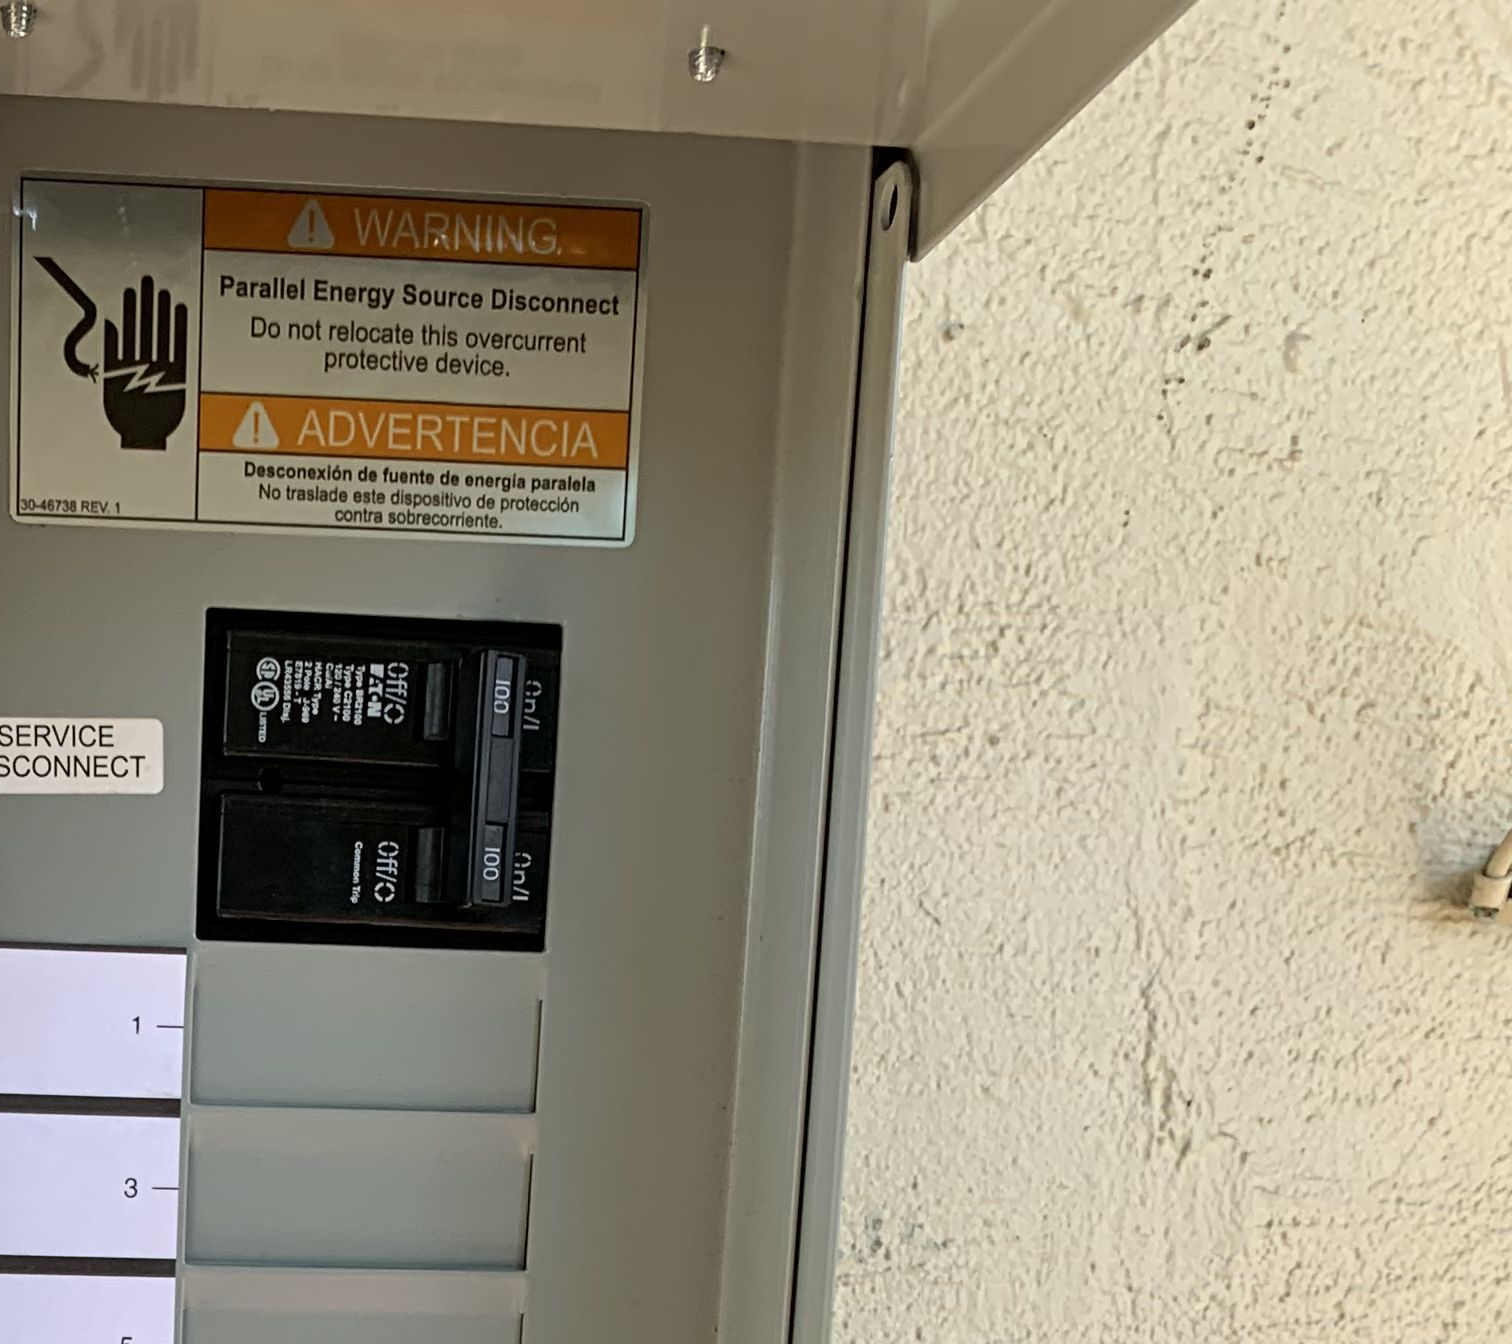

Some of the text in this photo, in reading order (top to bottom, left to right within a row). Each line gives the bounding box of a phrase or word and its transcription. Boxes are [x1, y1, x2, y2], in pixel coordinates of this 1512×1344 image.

[354, 208, 558, 255] WARNING
[220, 275, 618, 315] Parallel Energy Source Disconnect
[251, 317, 586, 352] Do not relocate this overcurrent
[325, 349, 509, 377] protective device.
[297, 409, 598, 458] ADVERTENCIA
[244, 461, 595, 492] Desconexión de fuente de paralela
[21, 499, 110, 514] 30-46738 REV.
[259, 484, 579, 514] No traslade este dispositivo protección
[335, 509, 502, 529] contra sobrecorriente.
[355, 665, 365, 687] Type
[343, 664, 354, 722] Type C2100
[494, 680, 510, 714] 100
[351, 841, 363, 903] Common Trip
[483, 847, 500, 881] 100
[132, 1017, 139, 1034] 1
[124, 1178, 137, 1198] 3
